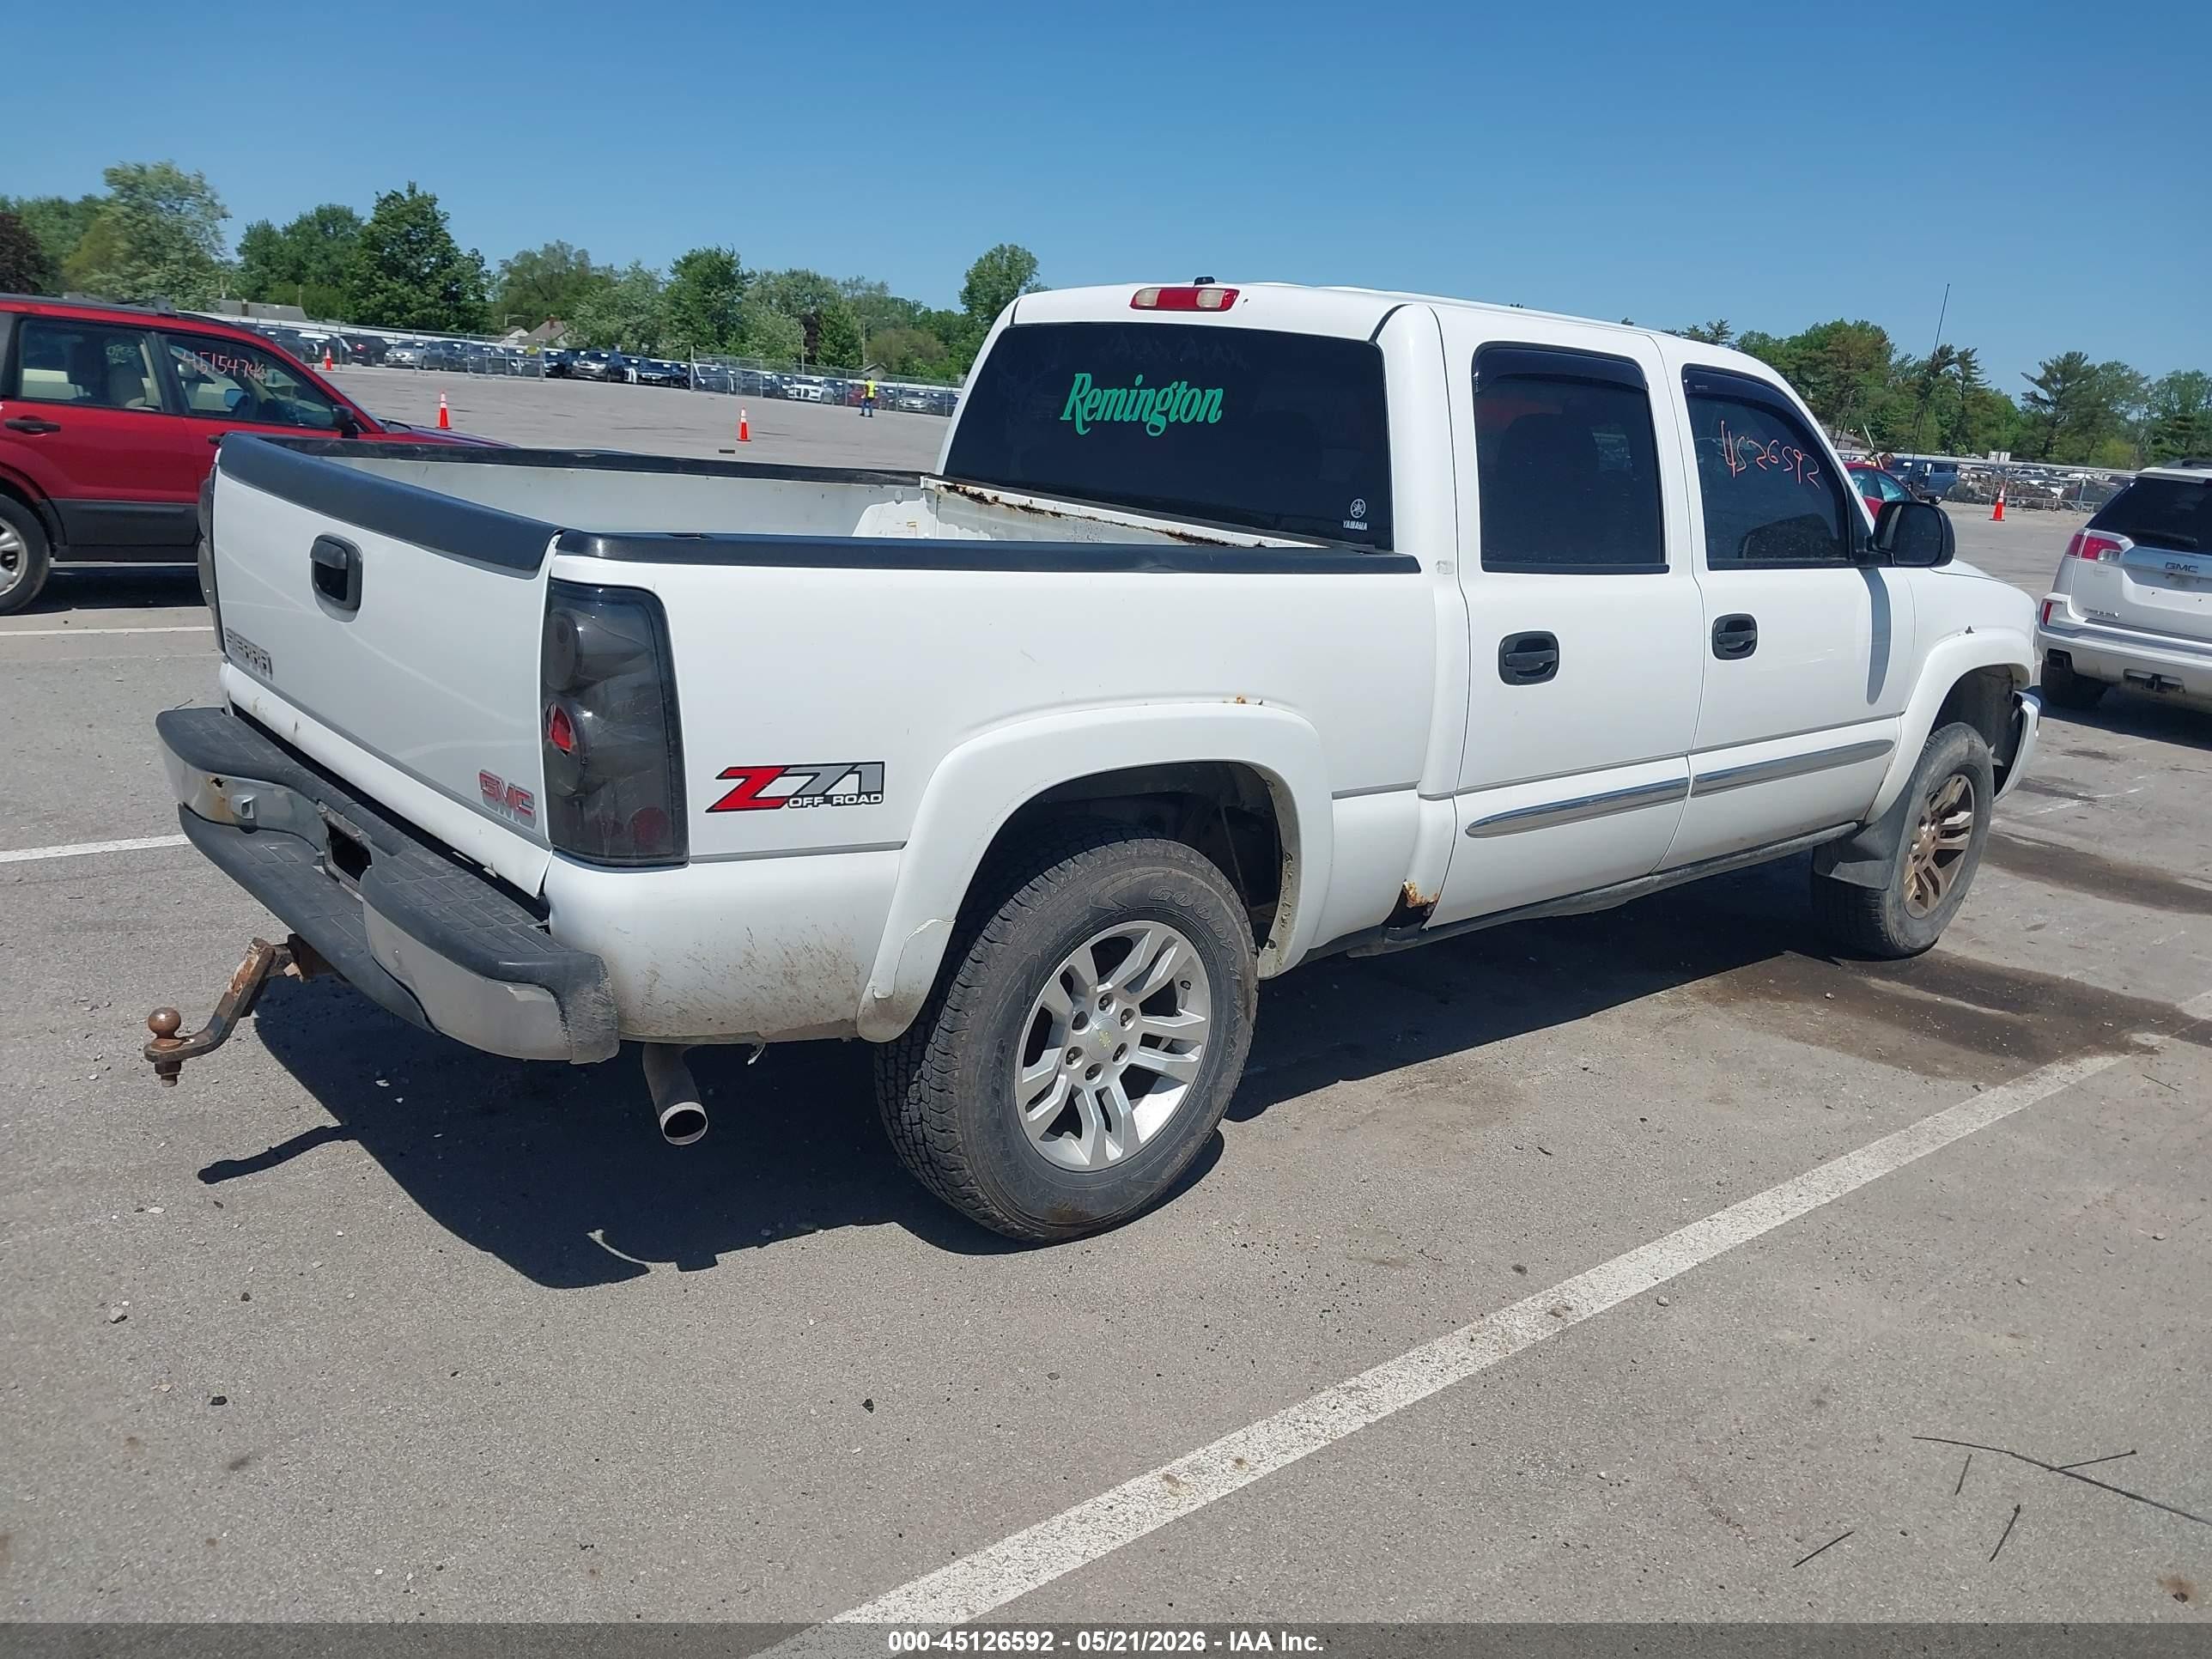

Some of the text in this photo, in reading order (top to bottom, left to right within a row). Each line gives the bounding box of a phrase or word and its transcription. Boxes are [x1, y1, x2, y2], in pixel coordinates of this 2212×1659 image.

[1060, 373, 1224, 437] Remington
[1343, 520, 1368, 532] YAMAHA
[2165, 562, 2199, 574] GMC
[478, 769, 535, 818] GMC
[705, 761, 885, 813] Z71
[788, 793, 884, 808] OFF ROAD
